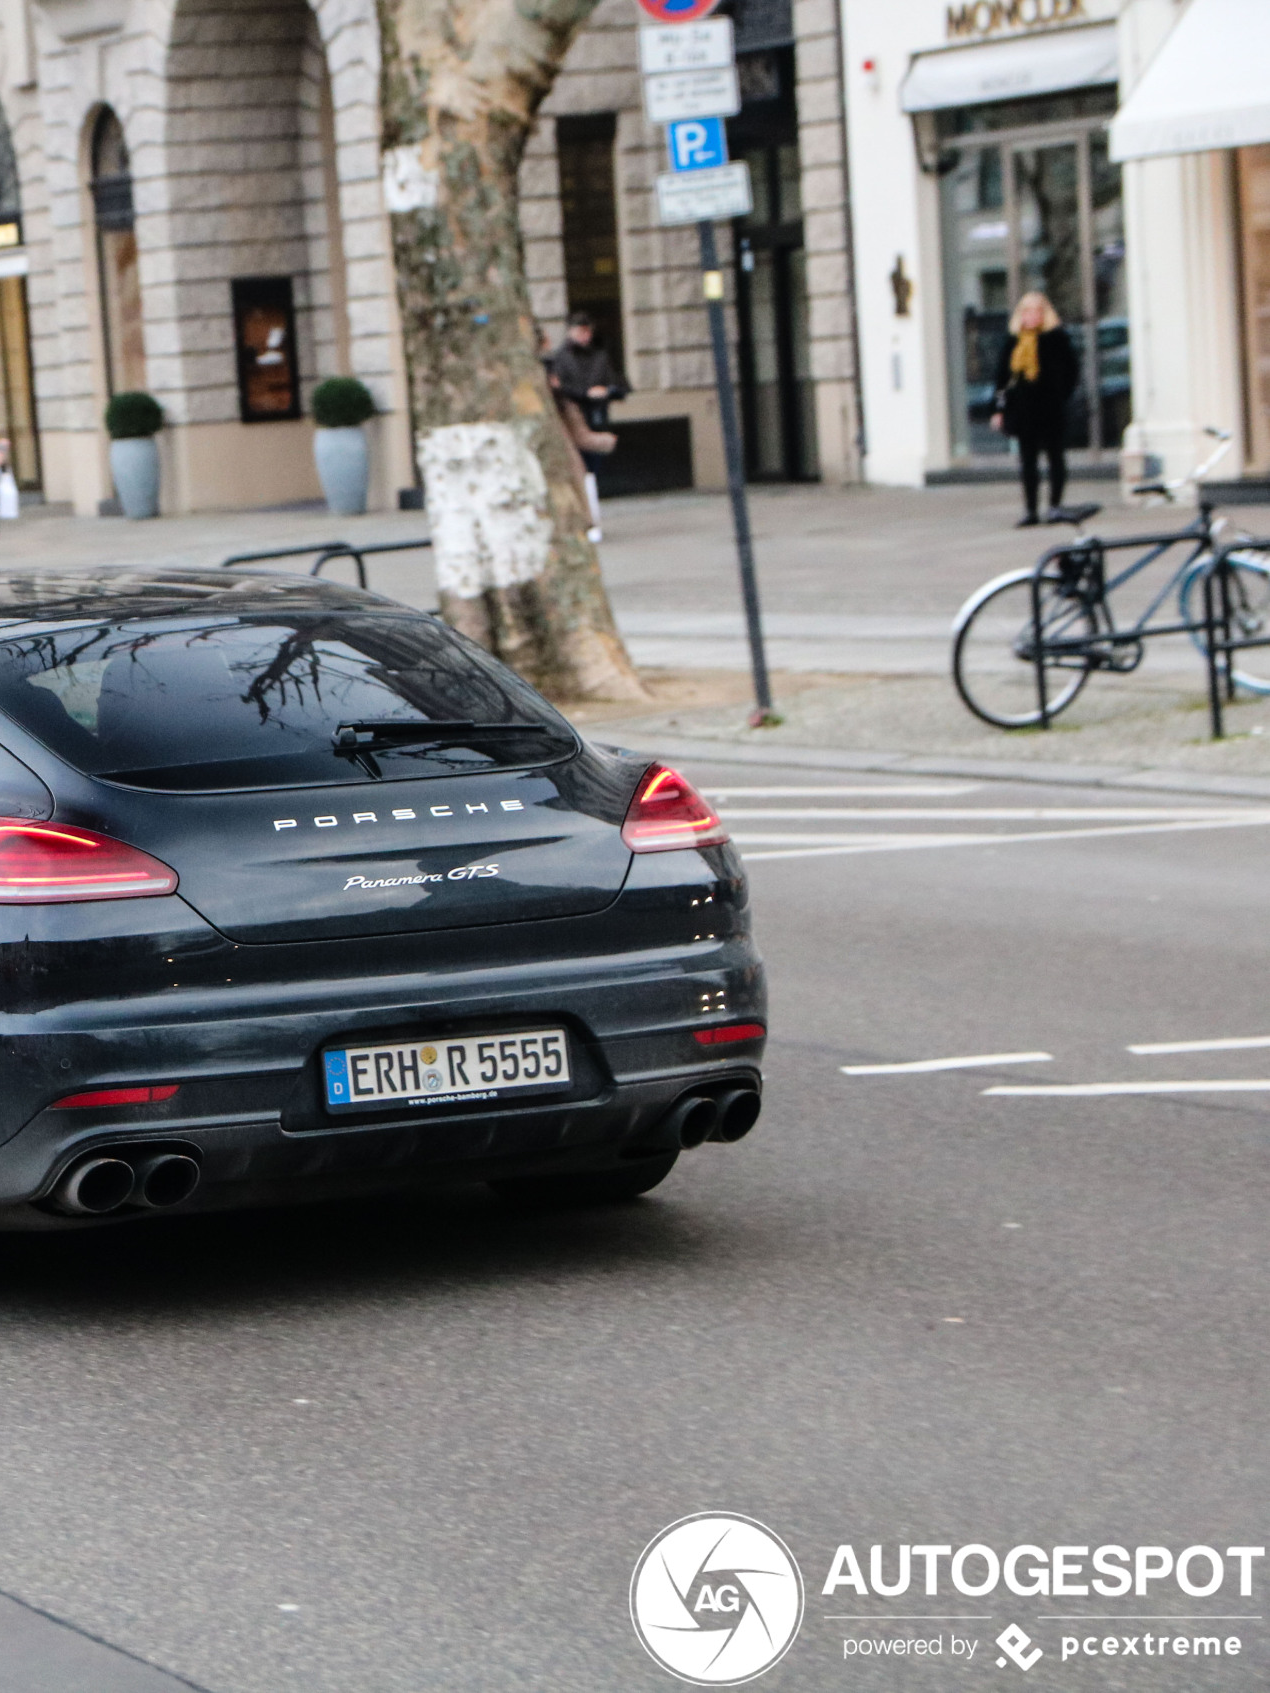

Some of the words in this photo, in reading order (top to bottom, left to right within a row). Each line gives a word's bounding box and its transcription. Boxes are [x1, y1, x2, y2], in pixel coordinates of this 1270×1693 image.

[674, 122, 708, 167] P
[273, 800, 525, 831] PORSCHE
[343, 872, 444, 891] Panamera
[447, 863, 499, 881] GTS
[350, 1049, 421, 1096] ERH
[446, 1045, 471, 1087] R
[477, 1036, 562, 1083] 5555
[333, 1082, 343, 1096] D
